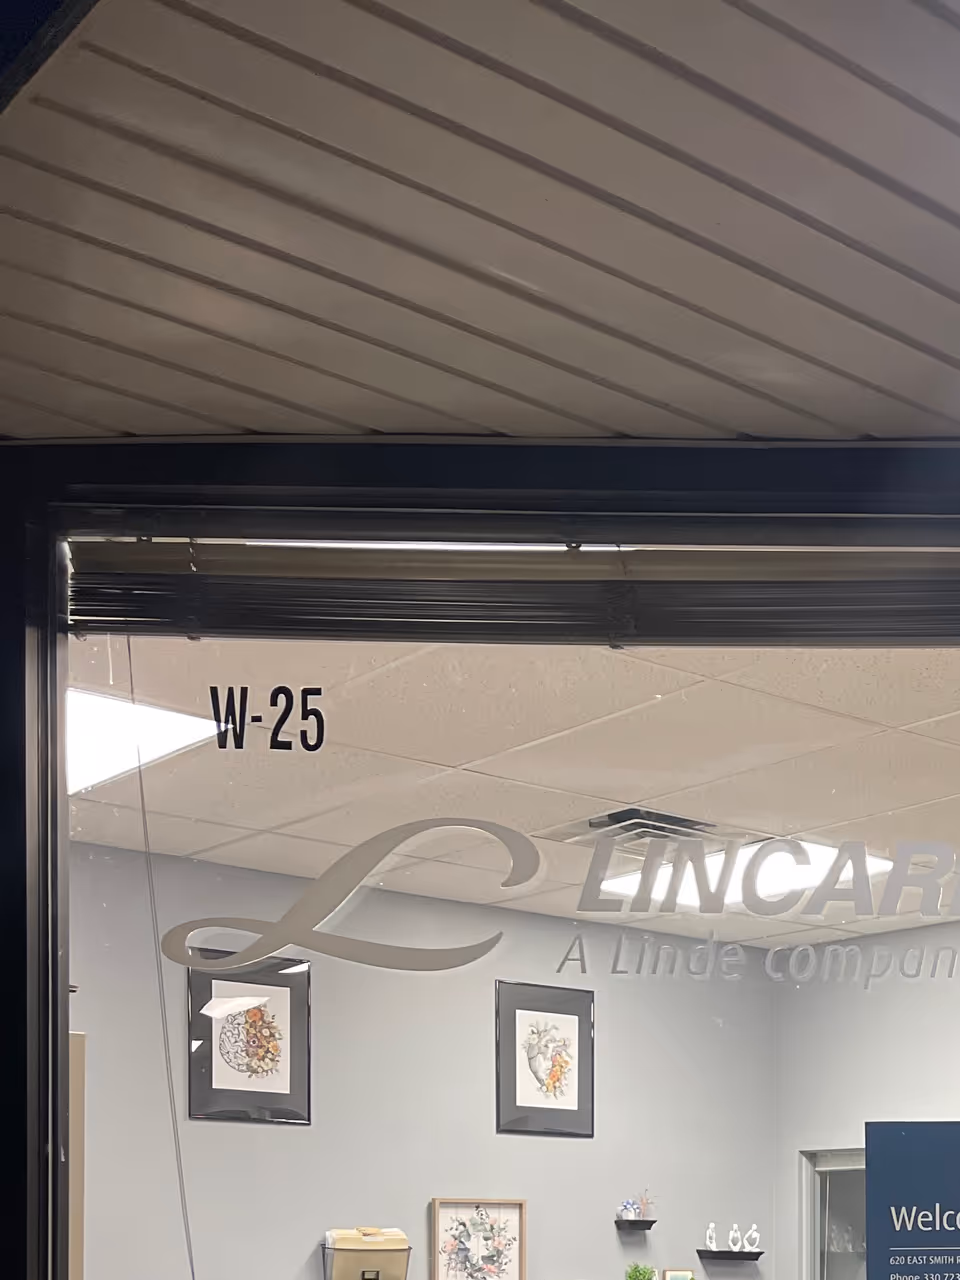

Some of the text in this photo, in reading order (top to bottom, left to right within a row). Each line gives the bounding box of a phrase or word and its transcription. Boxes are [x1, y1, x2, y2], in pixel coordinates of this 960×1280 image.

[209, 686, 324, 752] W-25
[556, 933, 587, 975] A
[610, 931, 746, 982] Linde
[889, 1256, 905, 1266] 620
[907, 1256, 927, 1265] EAST
[929, 1255, 955, 1265] SMITH
